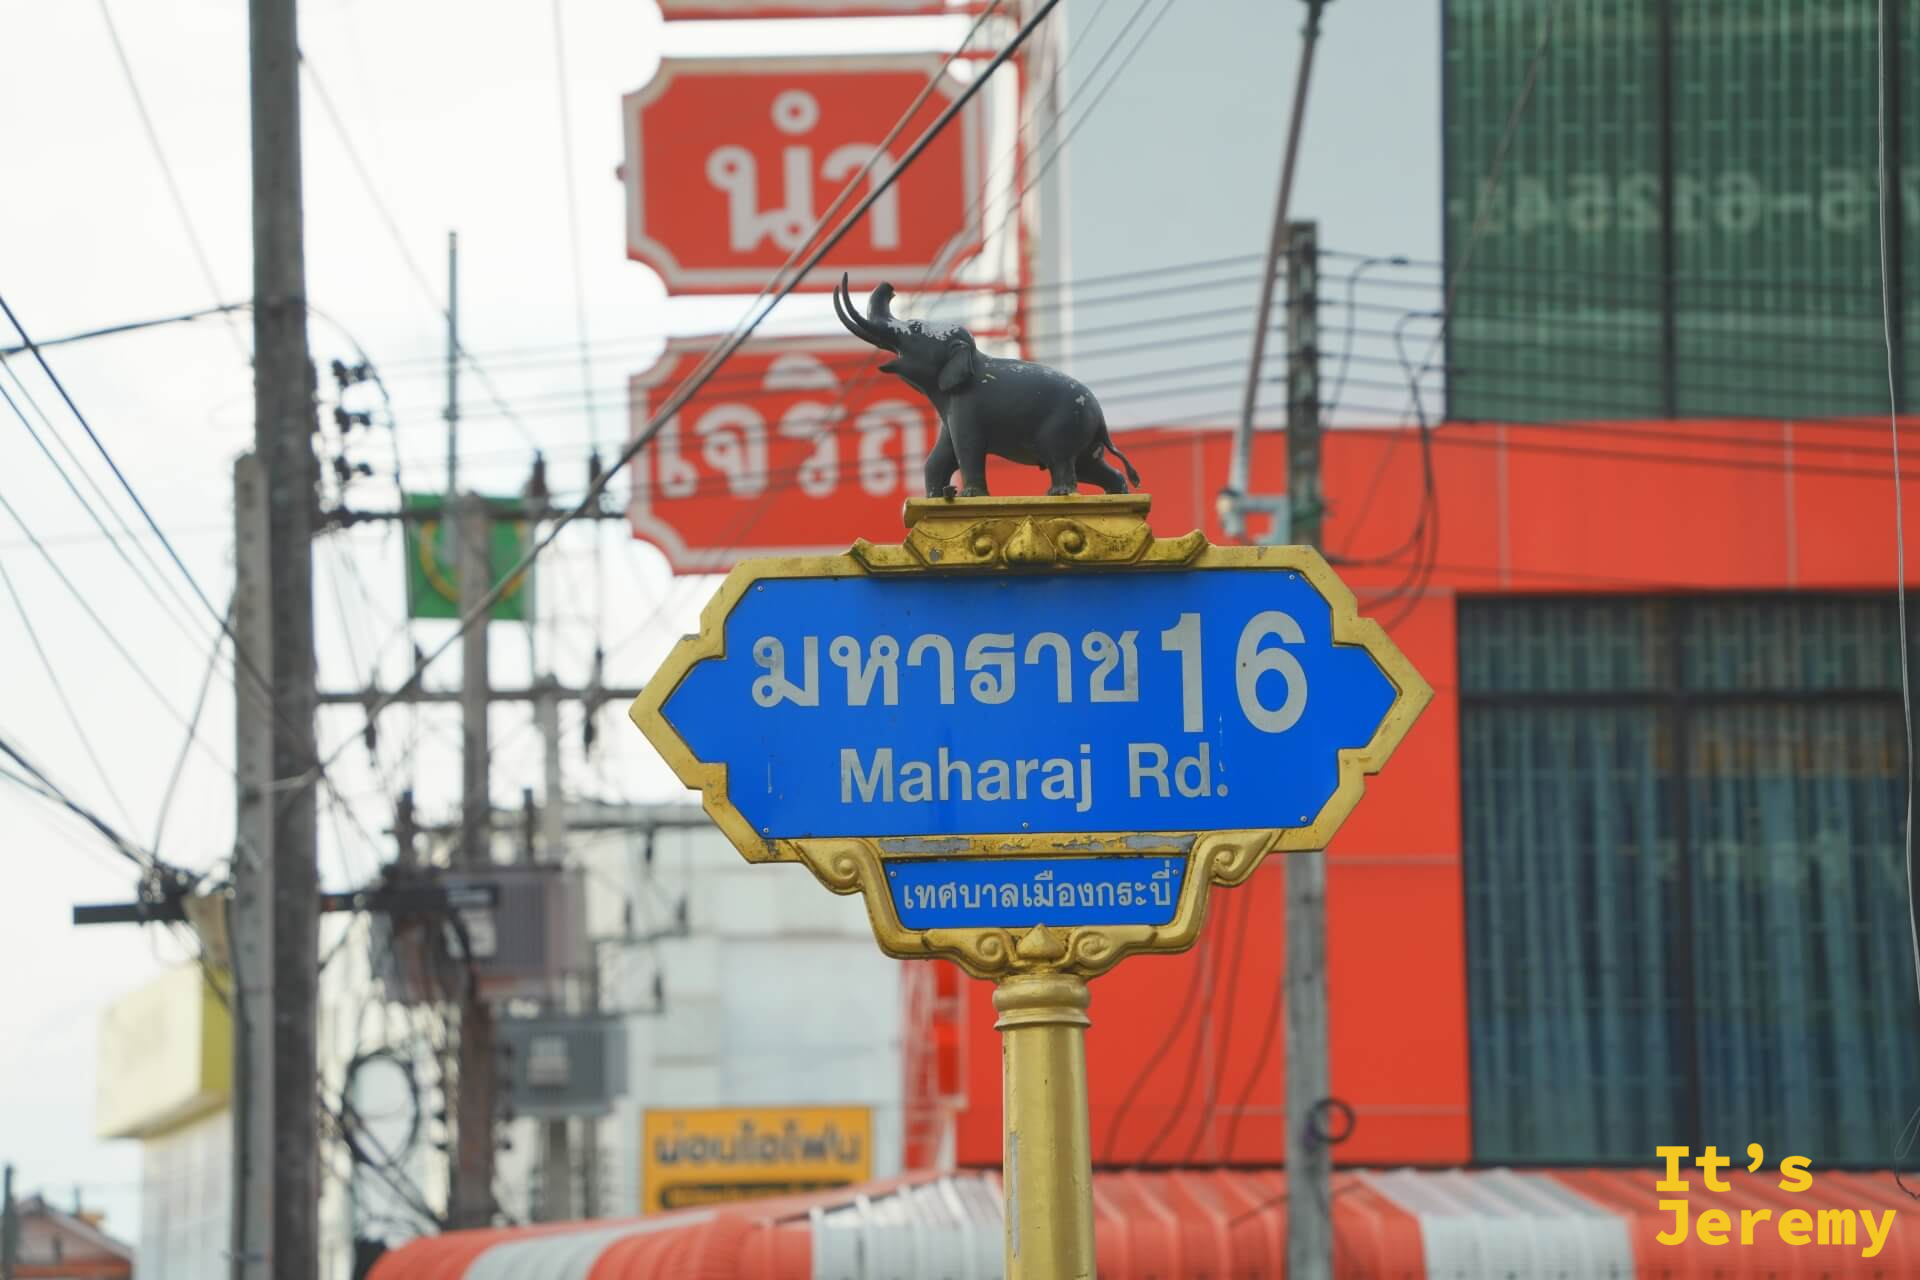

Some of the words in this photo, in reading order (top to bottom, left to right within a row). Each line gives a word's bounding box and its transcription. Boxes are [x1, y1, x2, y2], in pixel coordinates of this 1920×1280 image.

[705, 88, 900, 252] นำ
[751, 630, 1140, 708] มหาราช
[1160, 610, 1308, 733] 16
[839, 743, 1092, 812] Maharaj
[1128, 742, 1229, 799] Rd.
[903, 859, 1172, 909] เทศบาลเมืองกระบี่
